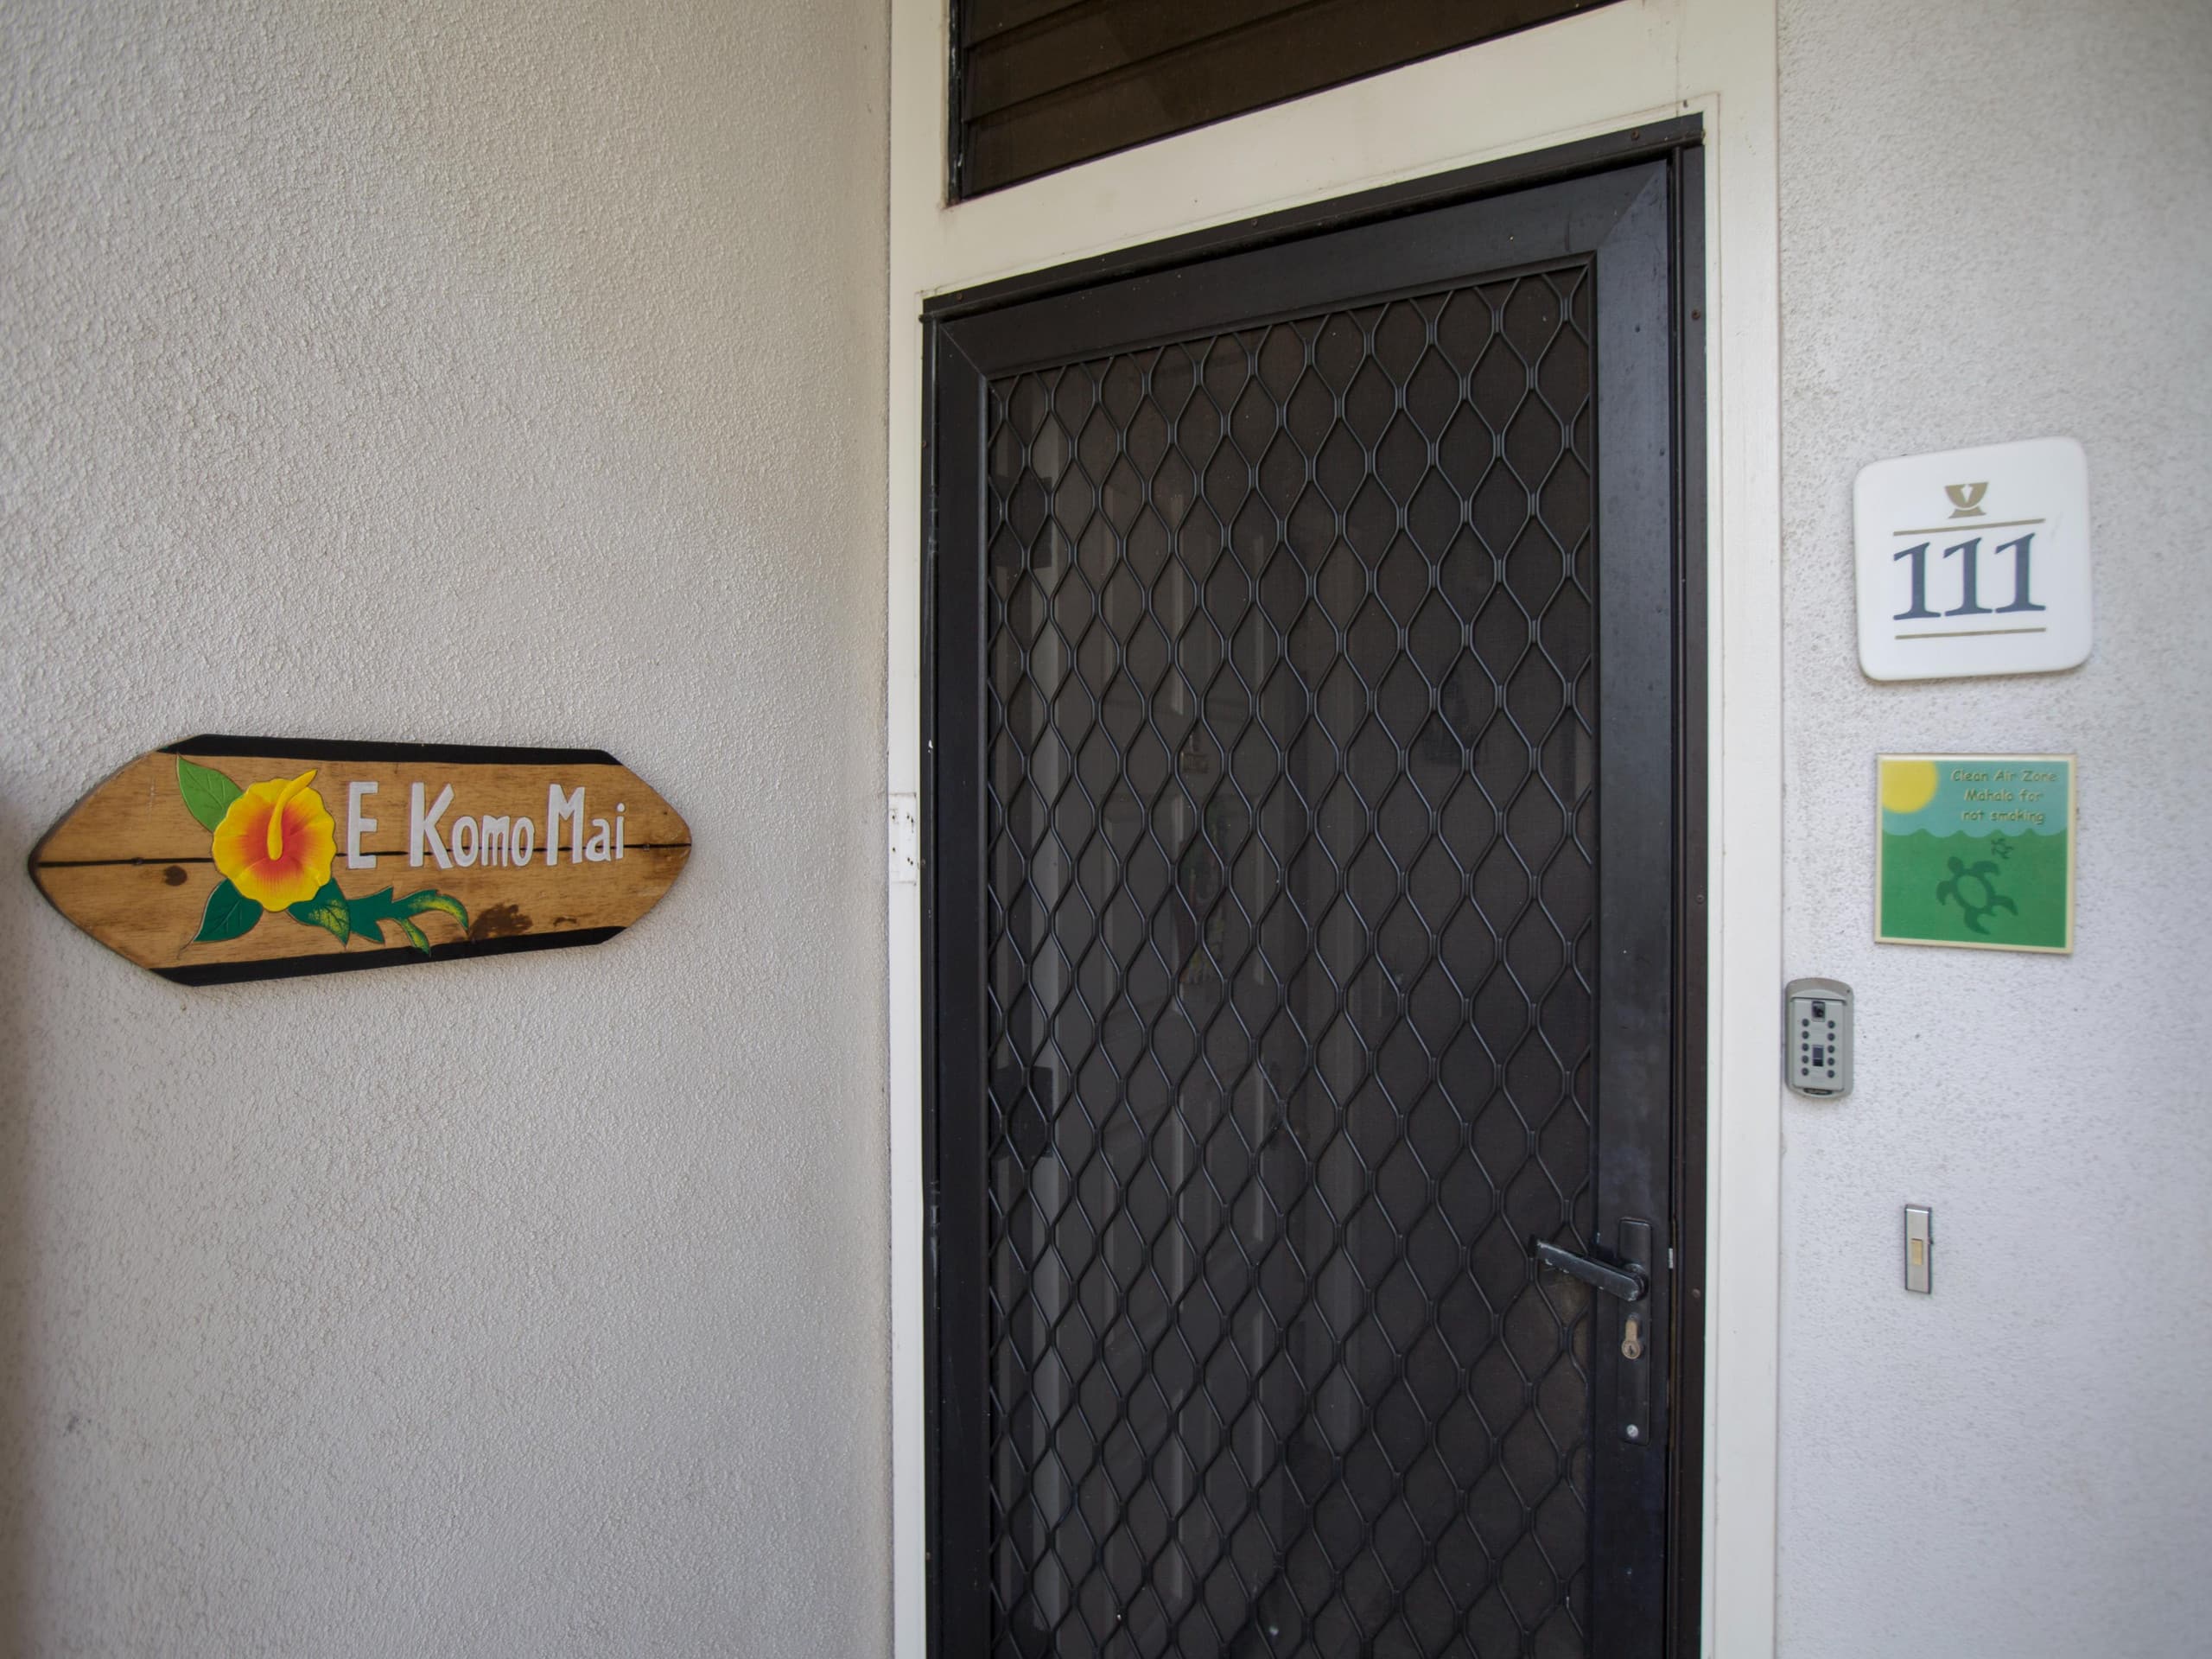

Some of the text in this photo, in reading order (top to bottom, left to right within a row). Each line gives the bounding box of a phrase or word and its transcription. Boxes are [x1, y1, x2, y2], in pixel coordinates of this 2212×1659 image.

[1892, 532, 2047, 620] 111
[1952, 769, 2056, 782] Clean Air Zone
[1964, 789, 2043, 802] Mahalo for
[347, 781, 626, 868] E Komo Mai
[1962, 809, 2045, 825] not smoking
